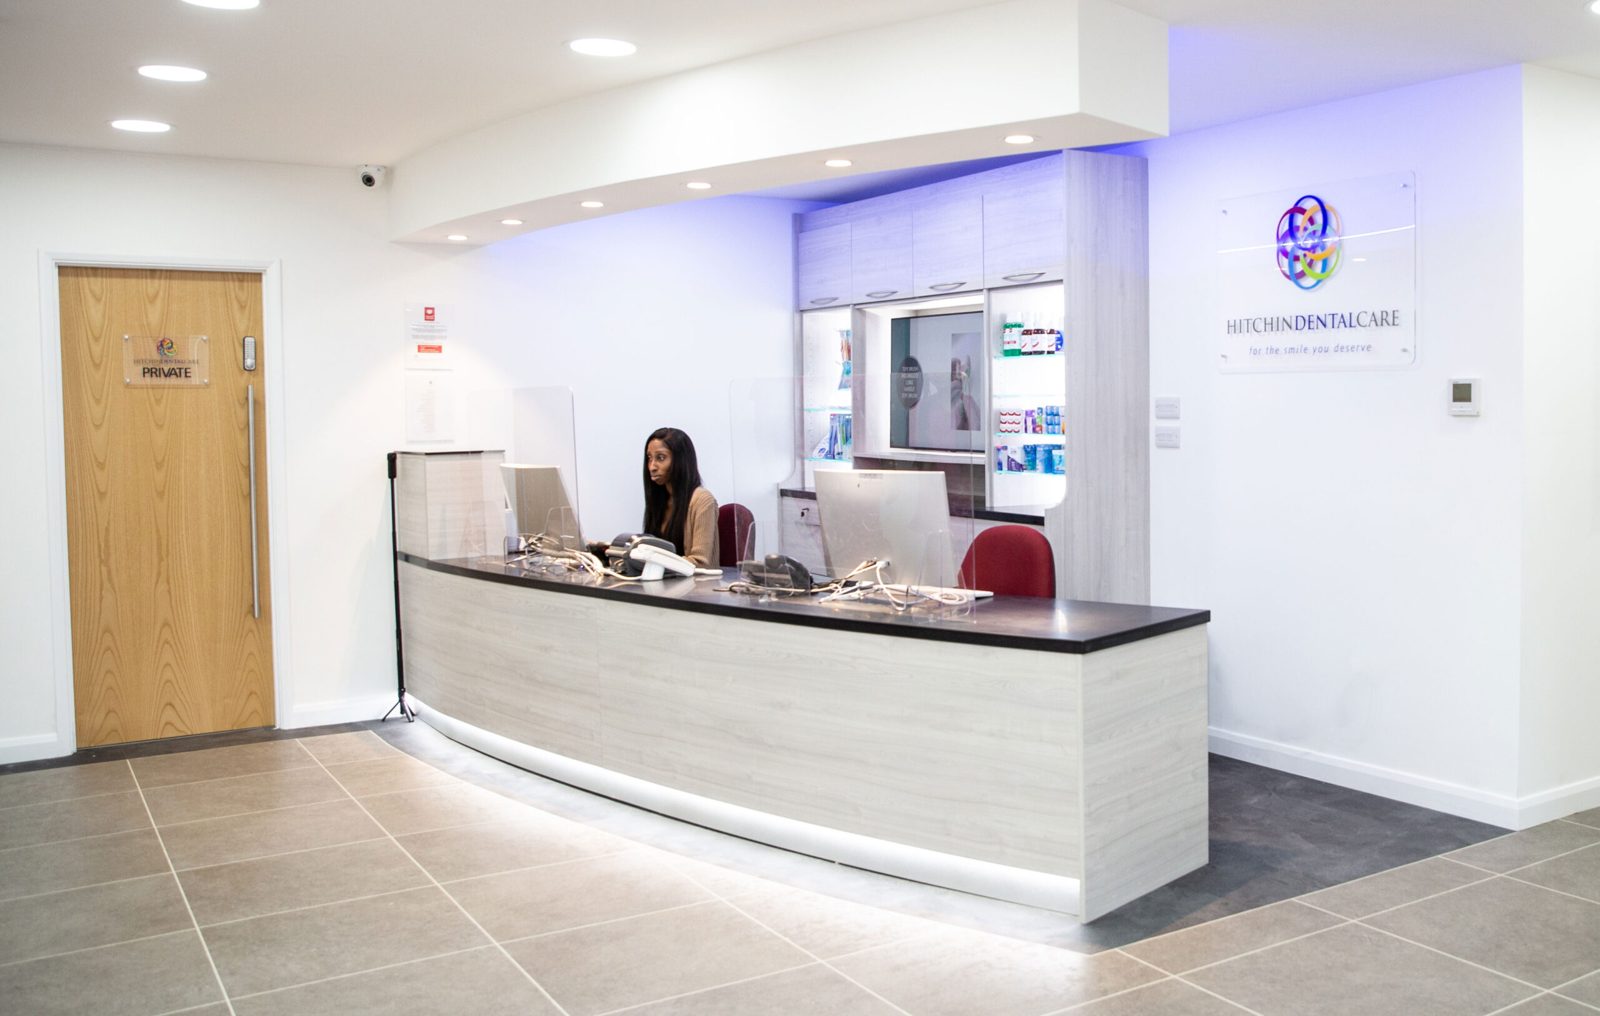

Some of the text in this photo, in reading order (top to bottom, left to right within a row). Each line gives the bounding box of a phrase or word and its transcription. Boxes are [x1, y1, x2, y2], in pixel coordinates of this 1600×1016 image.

[1227, 310, 1399, 334] HITCHINDENTALCARE
[1249, 343, 1372, 356] for the smile you deserve
[142, 367, 192, 378] PRIVATE
